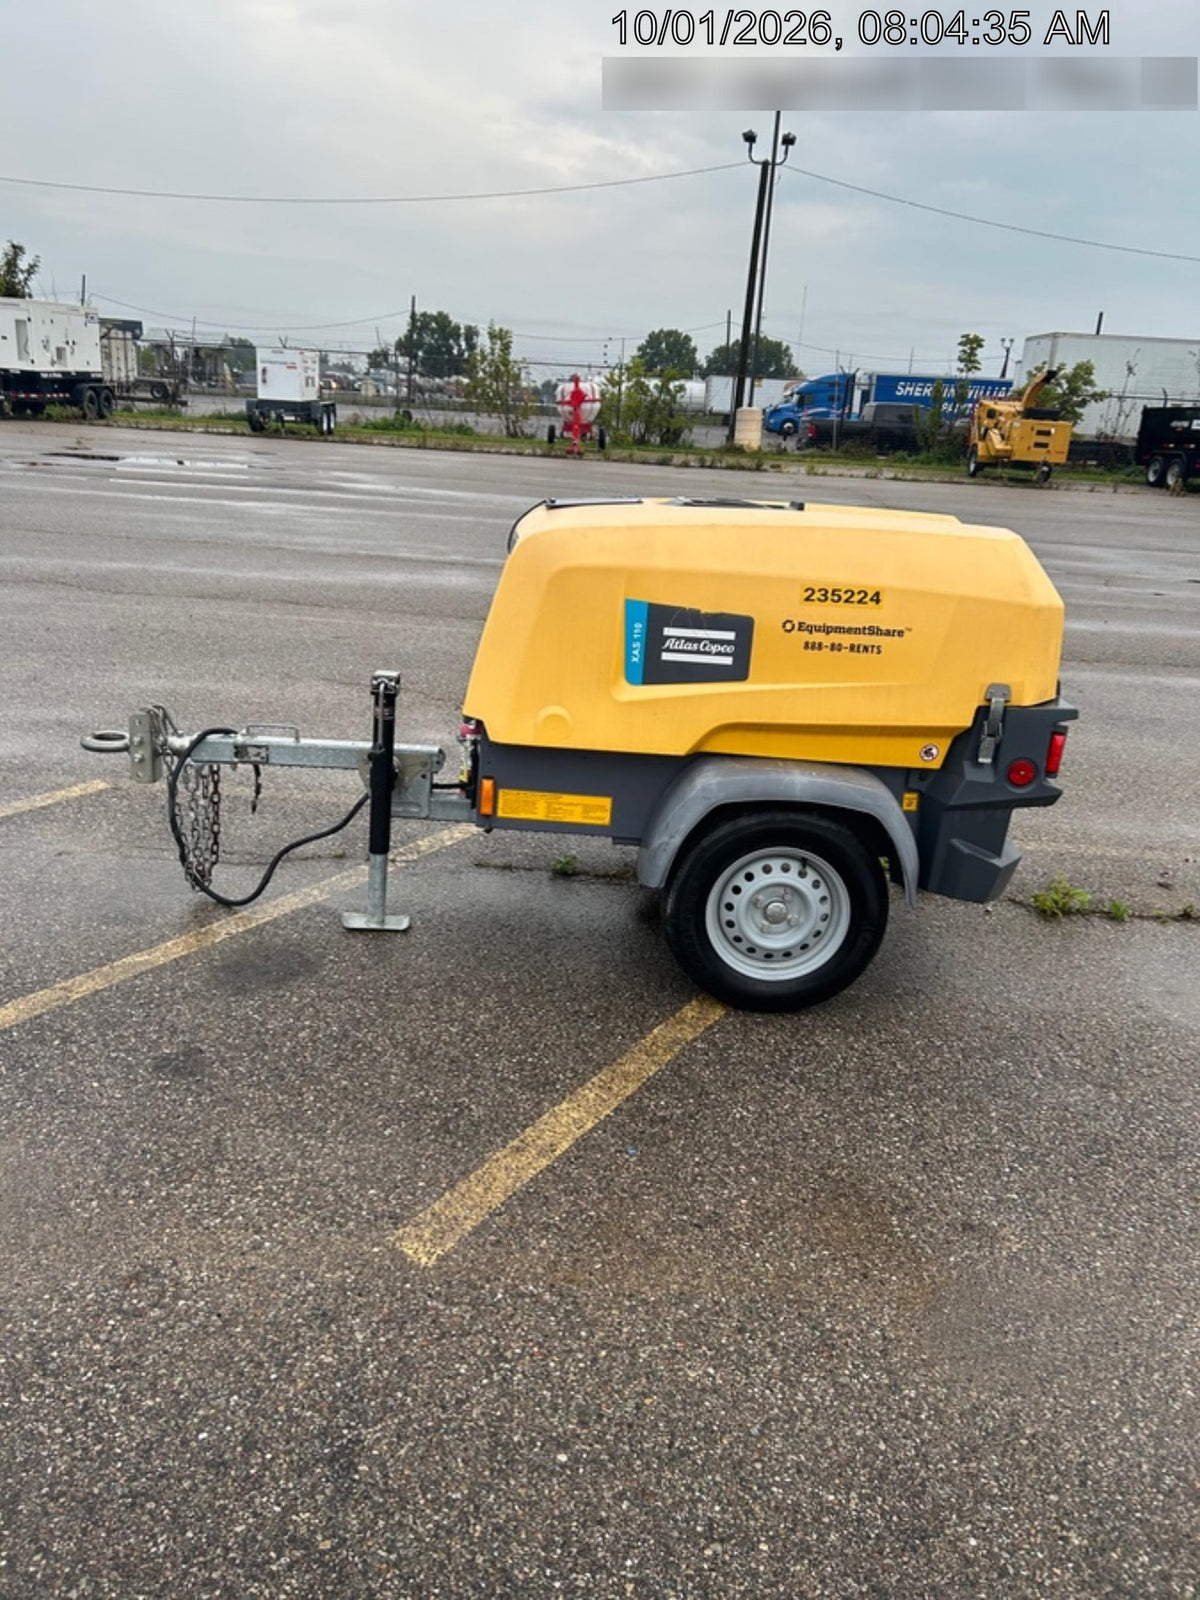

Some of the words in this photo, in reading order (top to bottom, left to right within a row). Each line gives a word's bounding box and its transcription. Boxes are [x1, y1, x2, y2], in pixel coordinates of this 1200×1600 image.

[803, 587, 881, 605] 235224
[630, 641, 641, 664] XAS
[662, 637, 698, 652] Atlas
[699, 640, 735, 655] Copco
[803, 641, 882, 655] 888-80-RENTS
